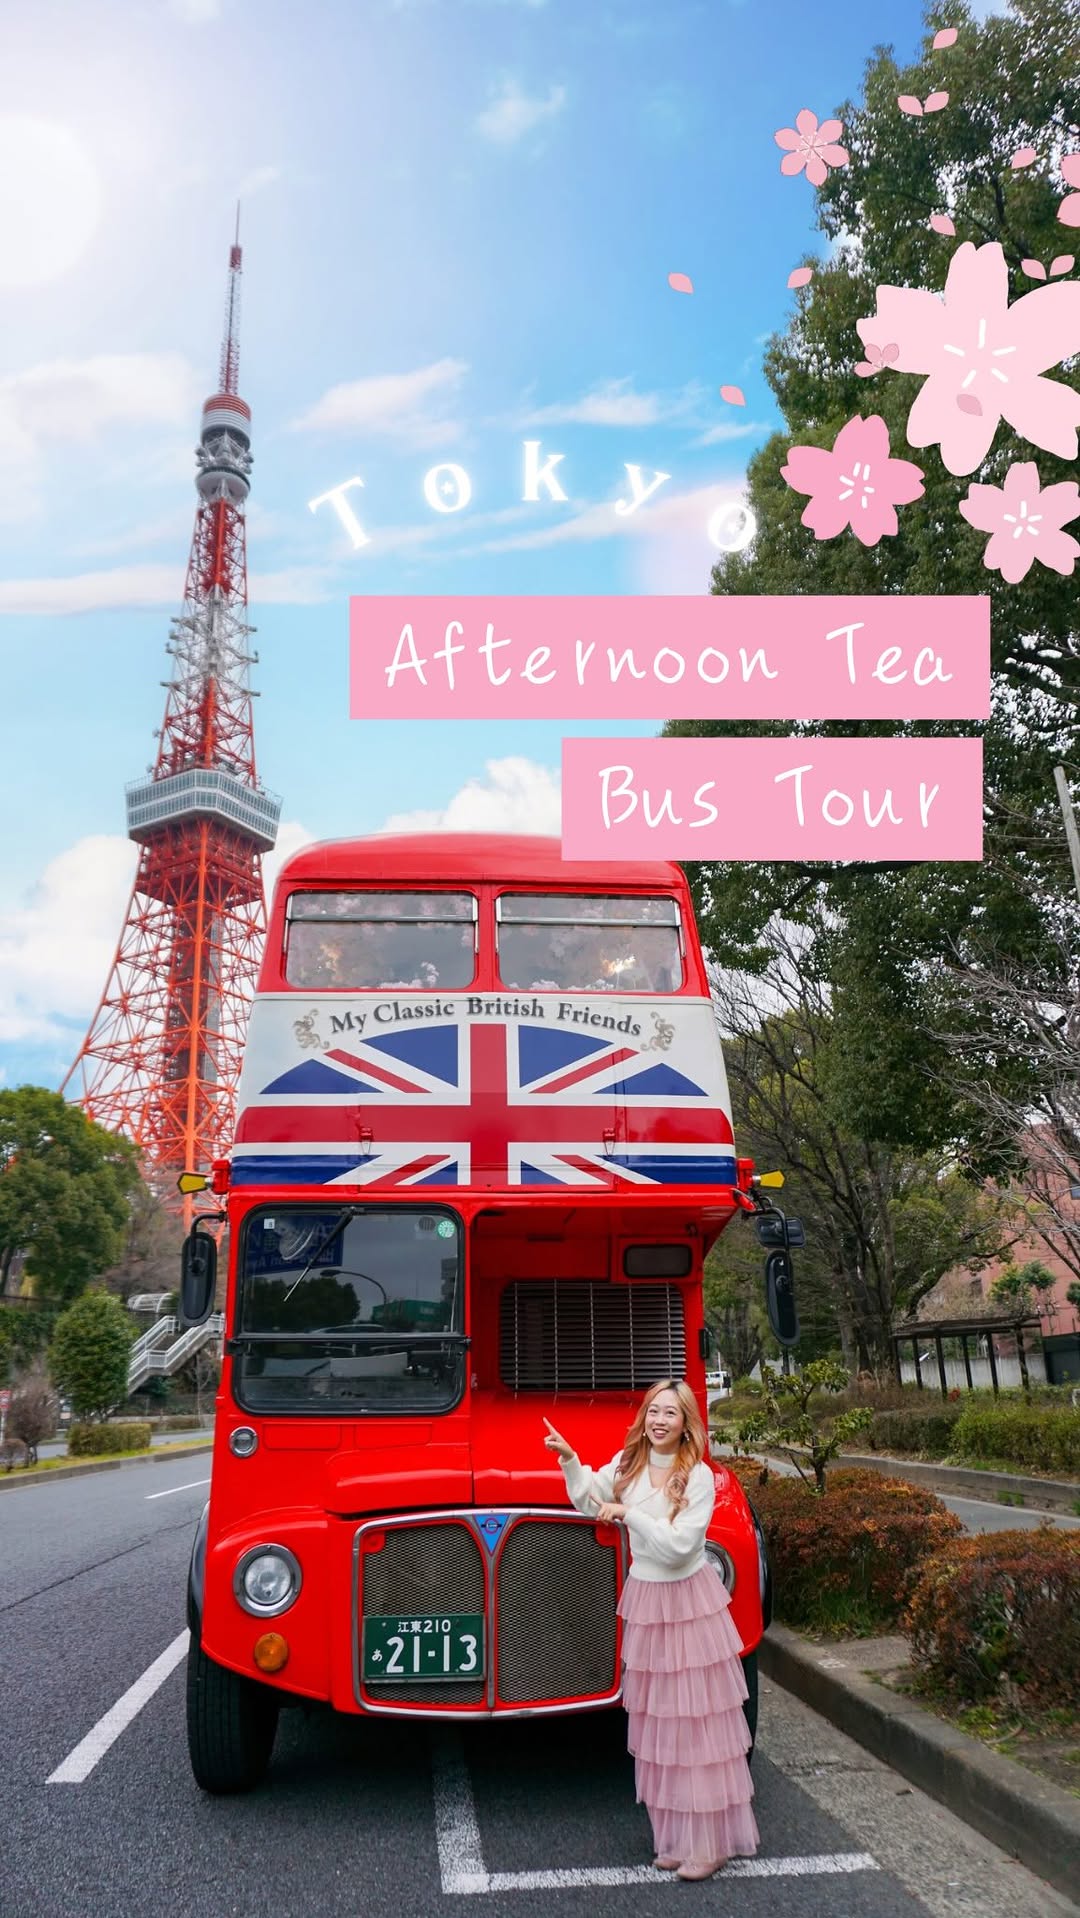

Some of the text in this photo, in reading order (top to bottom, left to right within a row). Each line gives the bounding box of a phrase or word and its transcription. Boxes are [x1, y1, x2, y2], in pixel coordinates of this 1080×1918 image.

[330, 996, 642, 1036] My Classic British Friends
[397, 1619, 451, 1633] 江東210
[371, 1634, 477, 1673] あ 21-13
